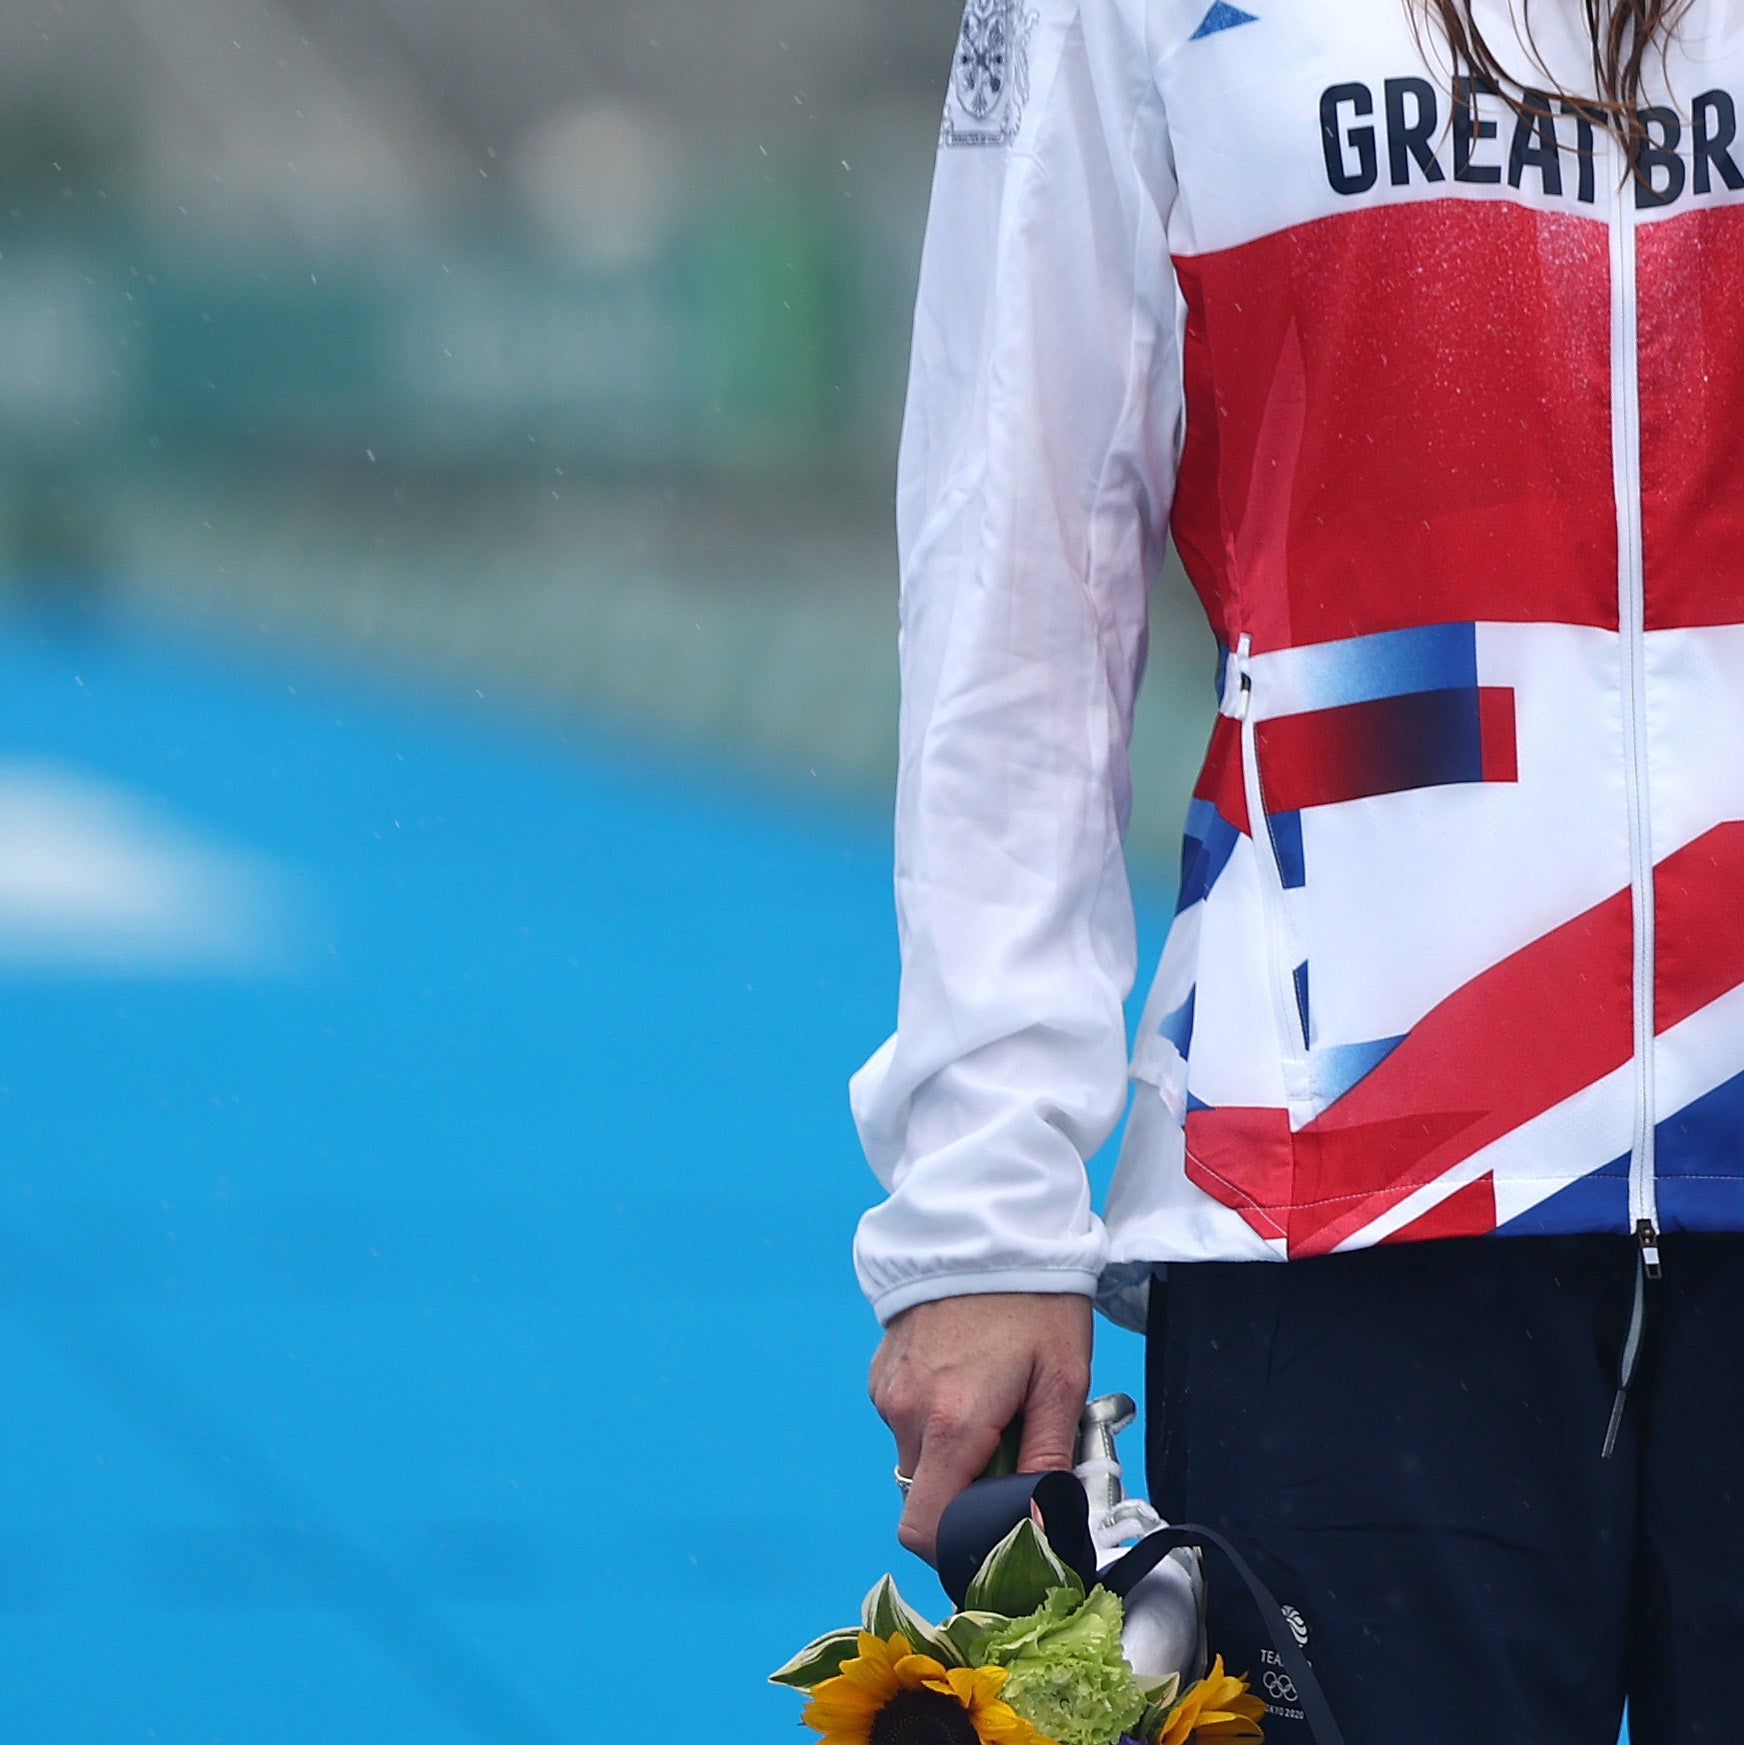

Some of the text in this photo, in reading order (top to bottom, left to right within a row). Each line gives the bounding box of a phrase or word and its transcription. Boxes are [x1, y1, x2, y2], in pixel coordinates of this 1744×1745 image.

[1318, 75, 1606, 205] GREAT
[1260, 1648, 1284, 1668] TEA
[1285, 1707, 1305, 1721] 2020
